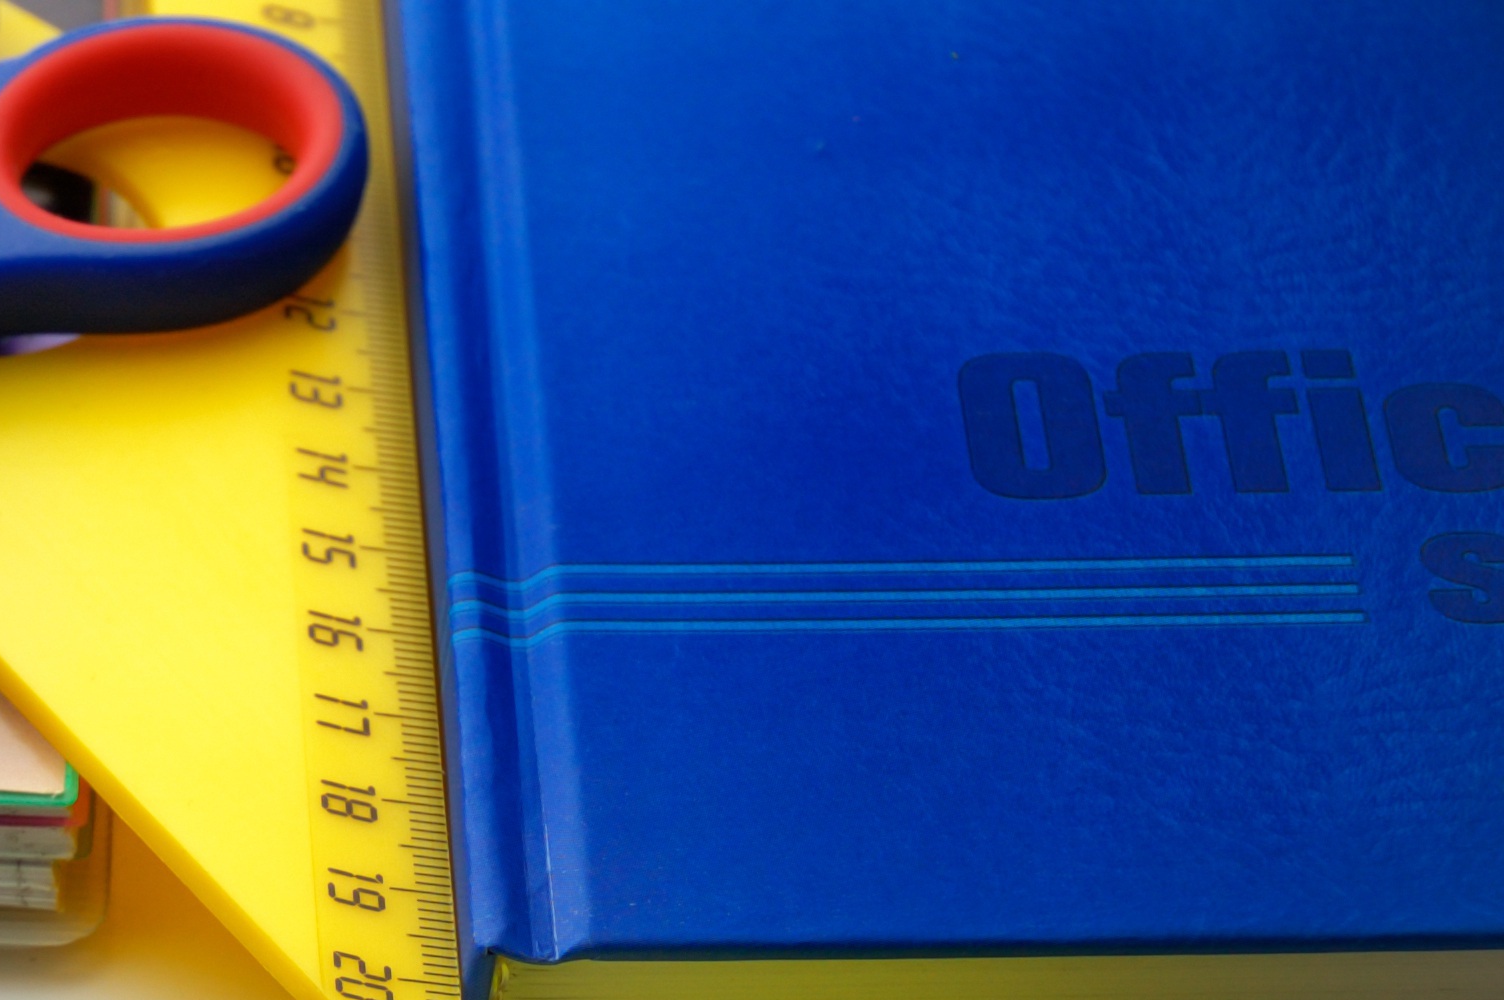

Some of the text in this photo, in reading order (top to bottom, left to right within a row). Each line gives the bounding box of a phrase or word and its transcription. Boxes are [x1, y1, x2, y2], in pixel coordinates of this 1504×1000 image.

[262, 4, 316, 29] 8
[284, 295, 337, 332] 12
[289, 368, 344, 410] 13
[957, 349, 1504, 500] Offic
[295, 447, 349, 489] 14
[301, 528, 357, 569] 15
[307, 609, 364, 652] 16
[314, 692, 371, 737] 17
[321, 778, 378, 823] 18
[327, 866, 386, 912] 19
